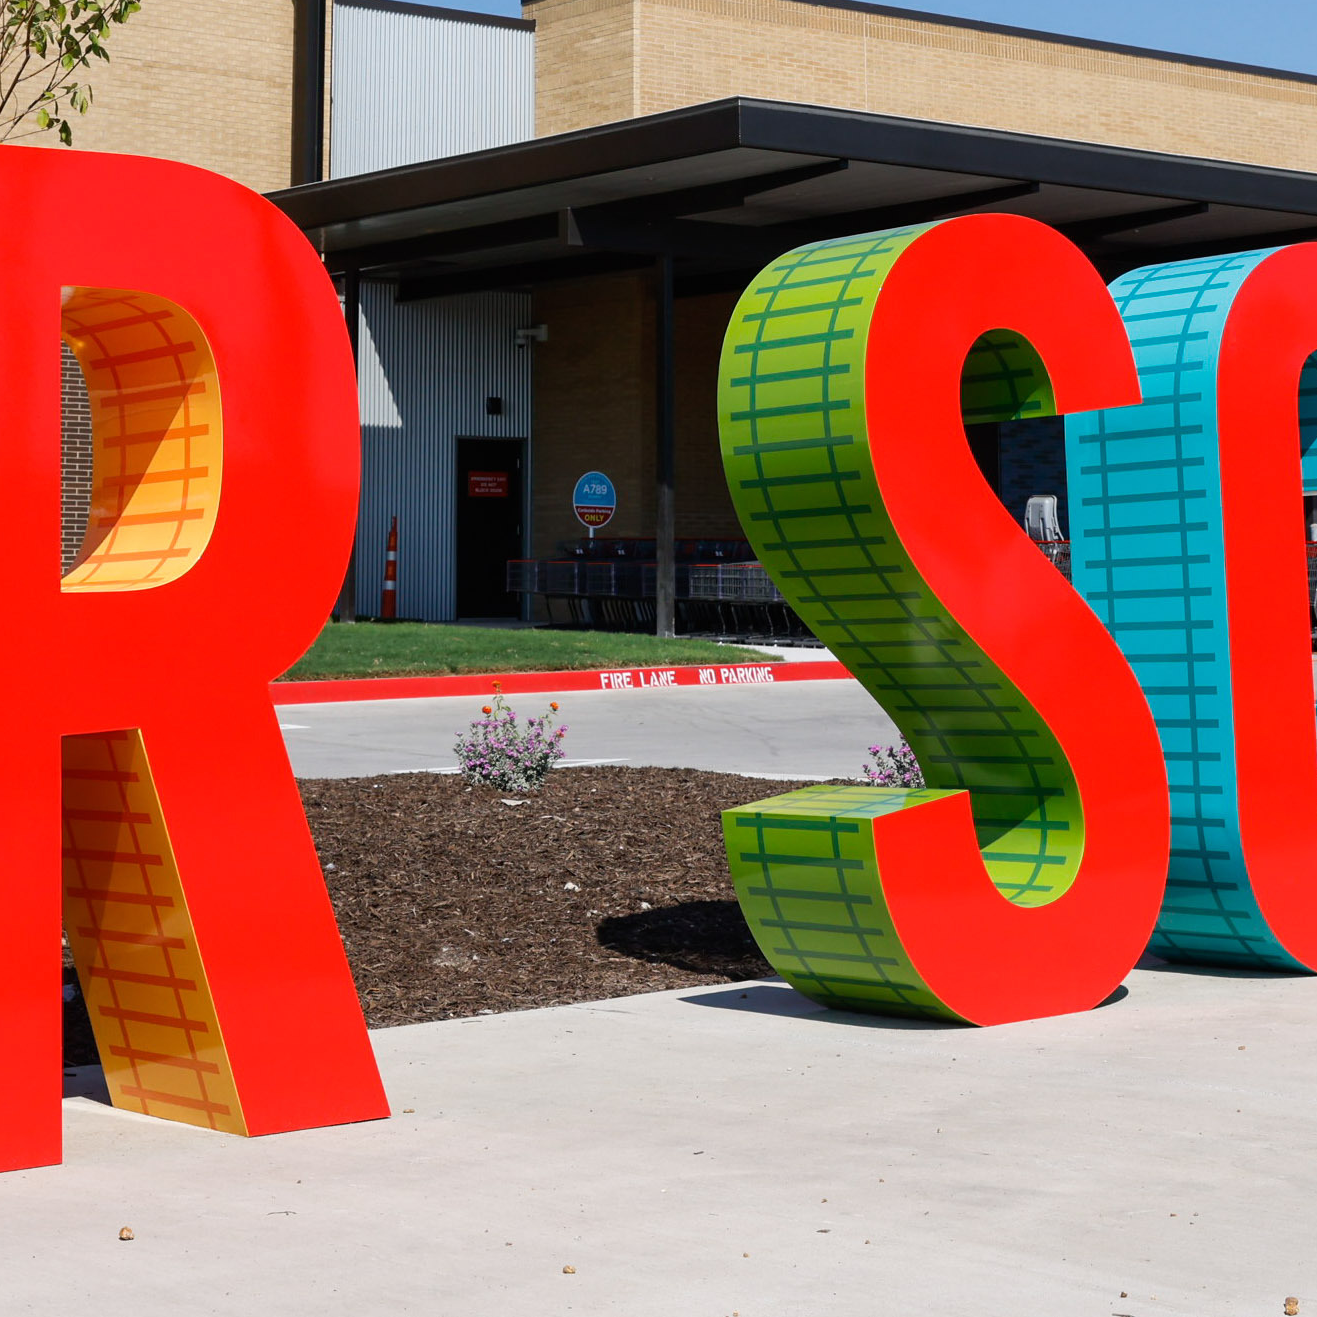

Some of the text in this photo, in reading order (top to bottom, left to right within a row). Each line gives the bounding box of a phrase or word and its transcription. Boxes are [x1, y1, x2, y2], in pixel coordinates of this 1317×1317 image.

[583, 484, 608, 495] A789
[584, 514, 604, 522] ONLY
[599, 666, 774, 689] FIRE LANE NO PARKING
